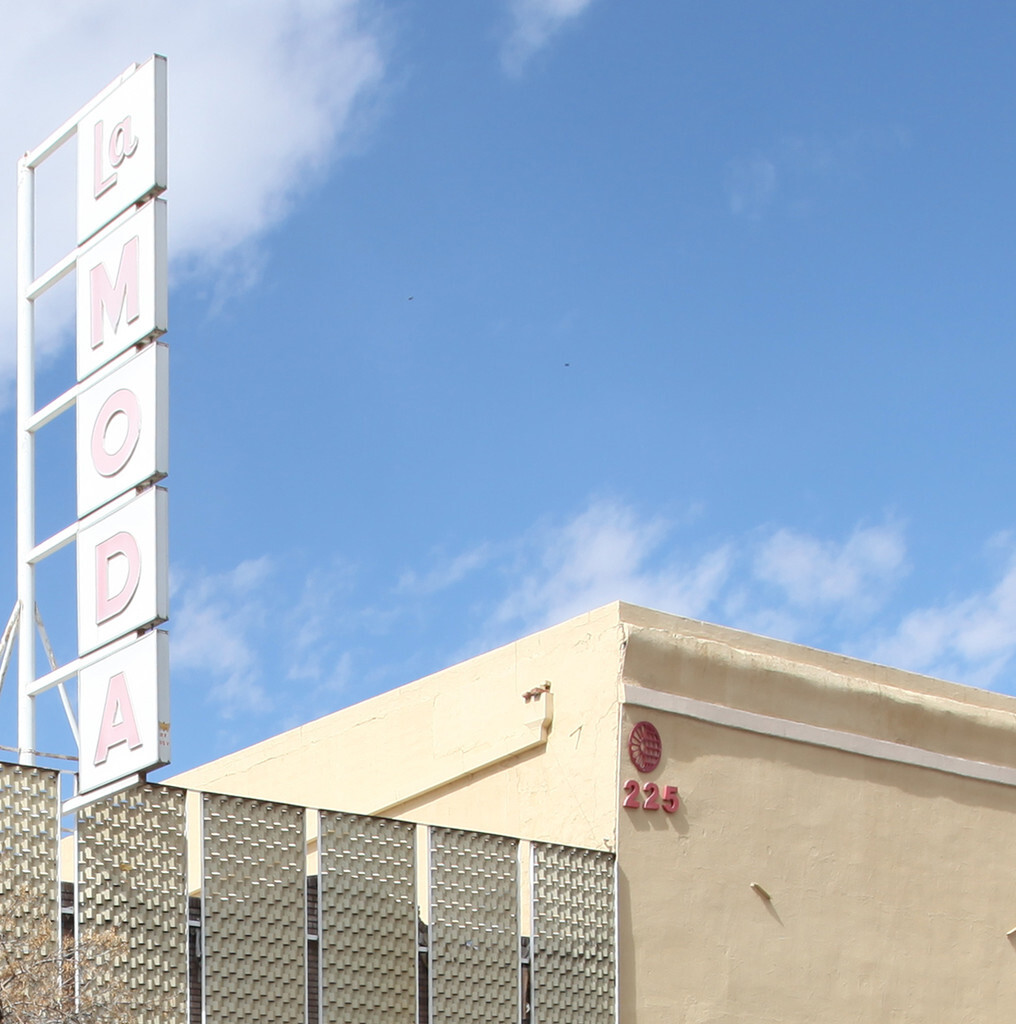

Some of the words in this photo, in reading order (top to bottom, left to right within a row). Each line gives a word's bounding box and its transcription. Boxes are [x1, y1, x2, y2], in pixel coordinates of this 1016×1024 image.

[94, 115, 139, 200] La
[89, 234, 143, 768] MODA
[622, 779, 681, 814] 225
